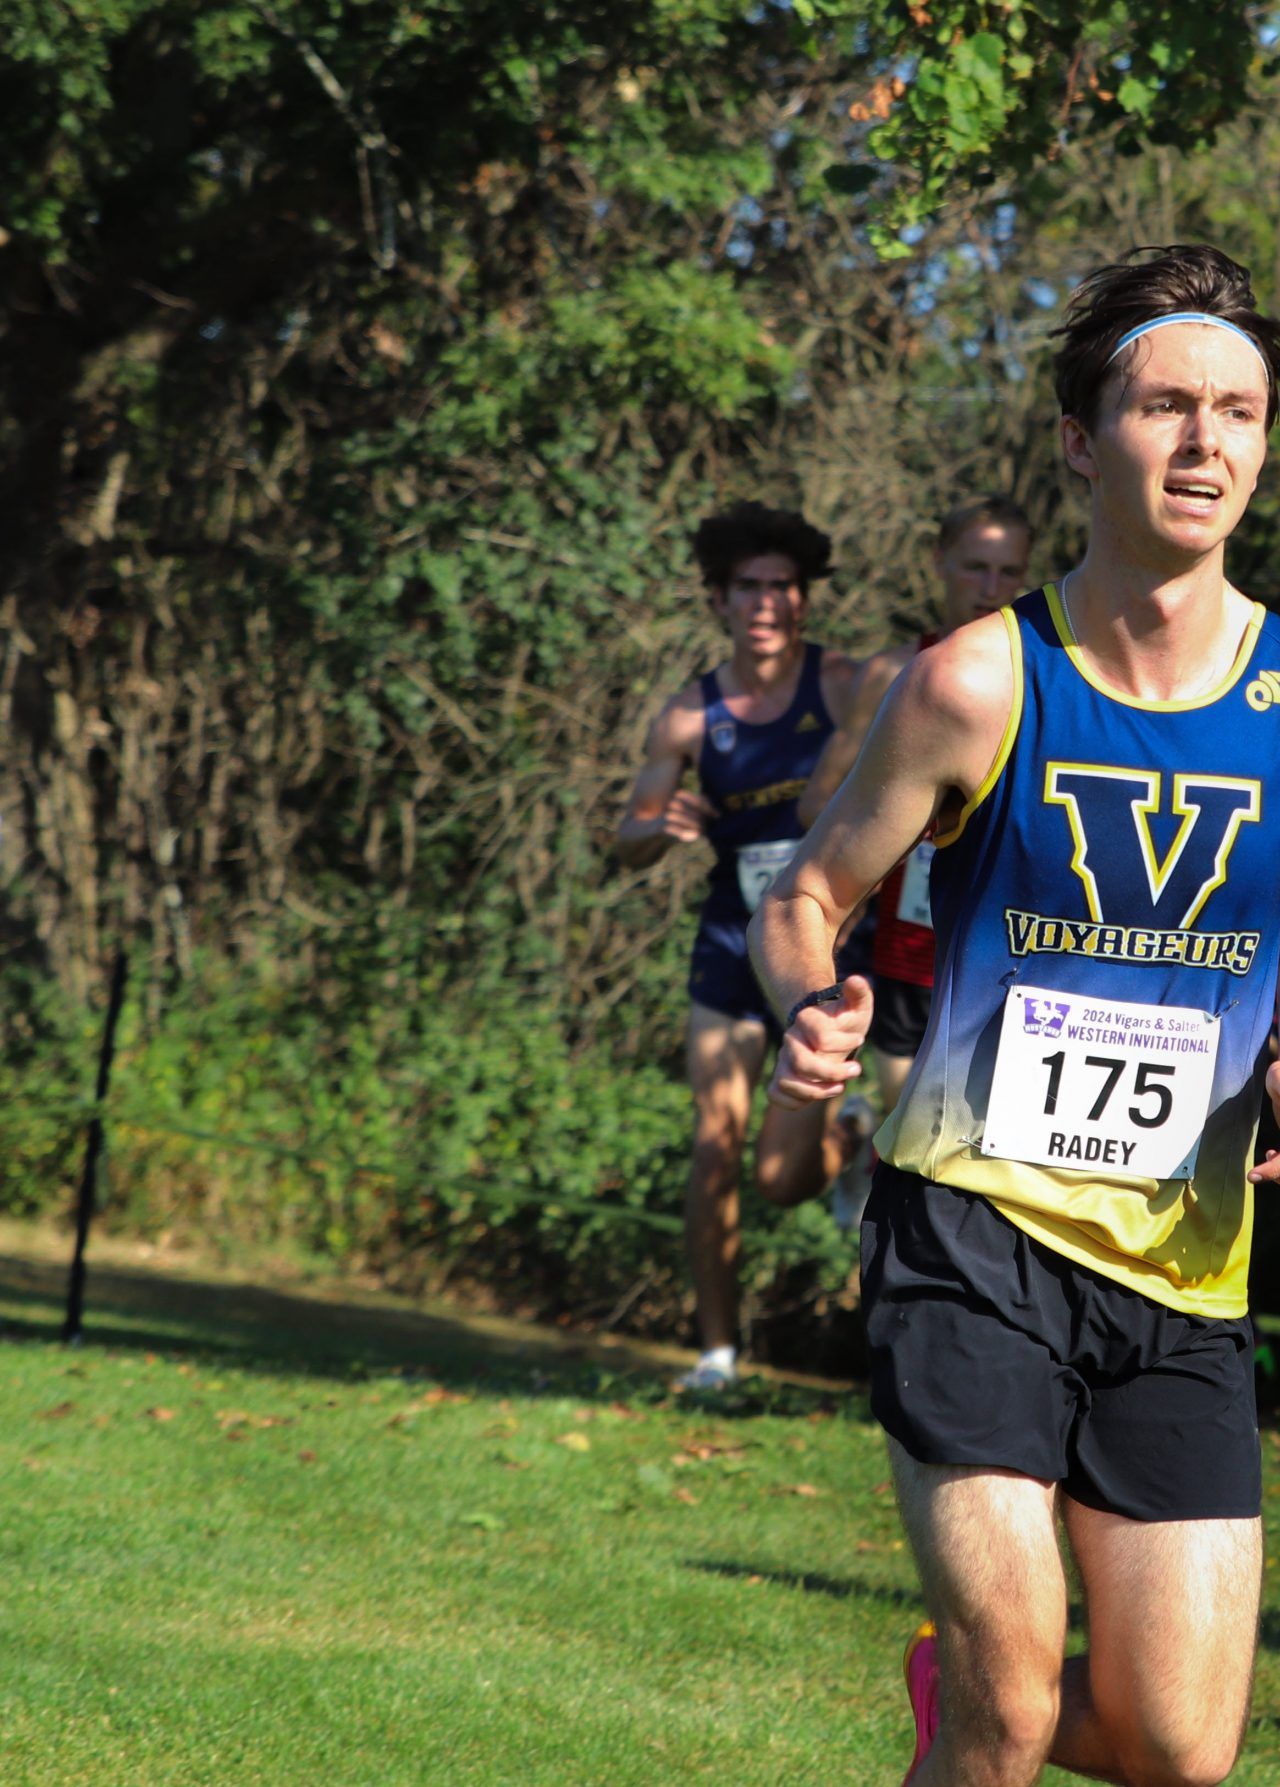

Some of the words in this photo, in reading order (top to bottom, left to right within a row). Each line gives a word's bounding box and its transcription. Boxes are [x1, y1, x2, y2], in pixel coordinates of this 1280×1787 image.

[1043, 761, 1261, 930] V
[1005, 908, 1261, 976] VOYAGEURS
[1067, 1025, 1126, 1046] WESTERN
[1128, 1034, 1210, 1054] INVITATIONAL
[1082, 1009, 1112, 1024] 2024
[1115, 1013, 1151, 1030] Vigars
[1154, 1018, 1164, 1030] &
[1168, 1019, 1200, 1033] Salter
[1041, 1050, 1176, 1129] 175
[1048, 1132, 1137, 1166] RADEY
